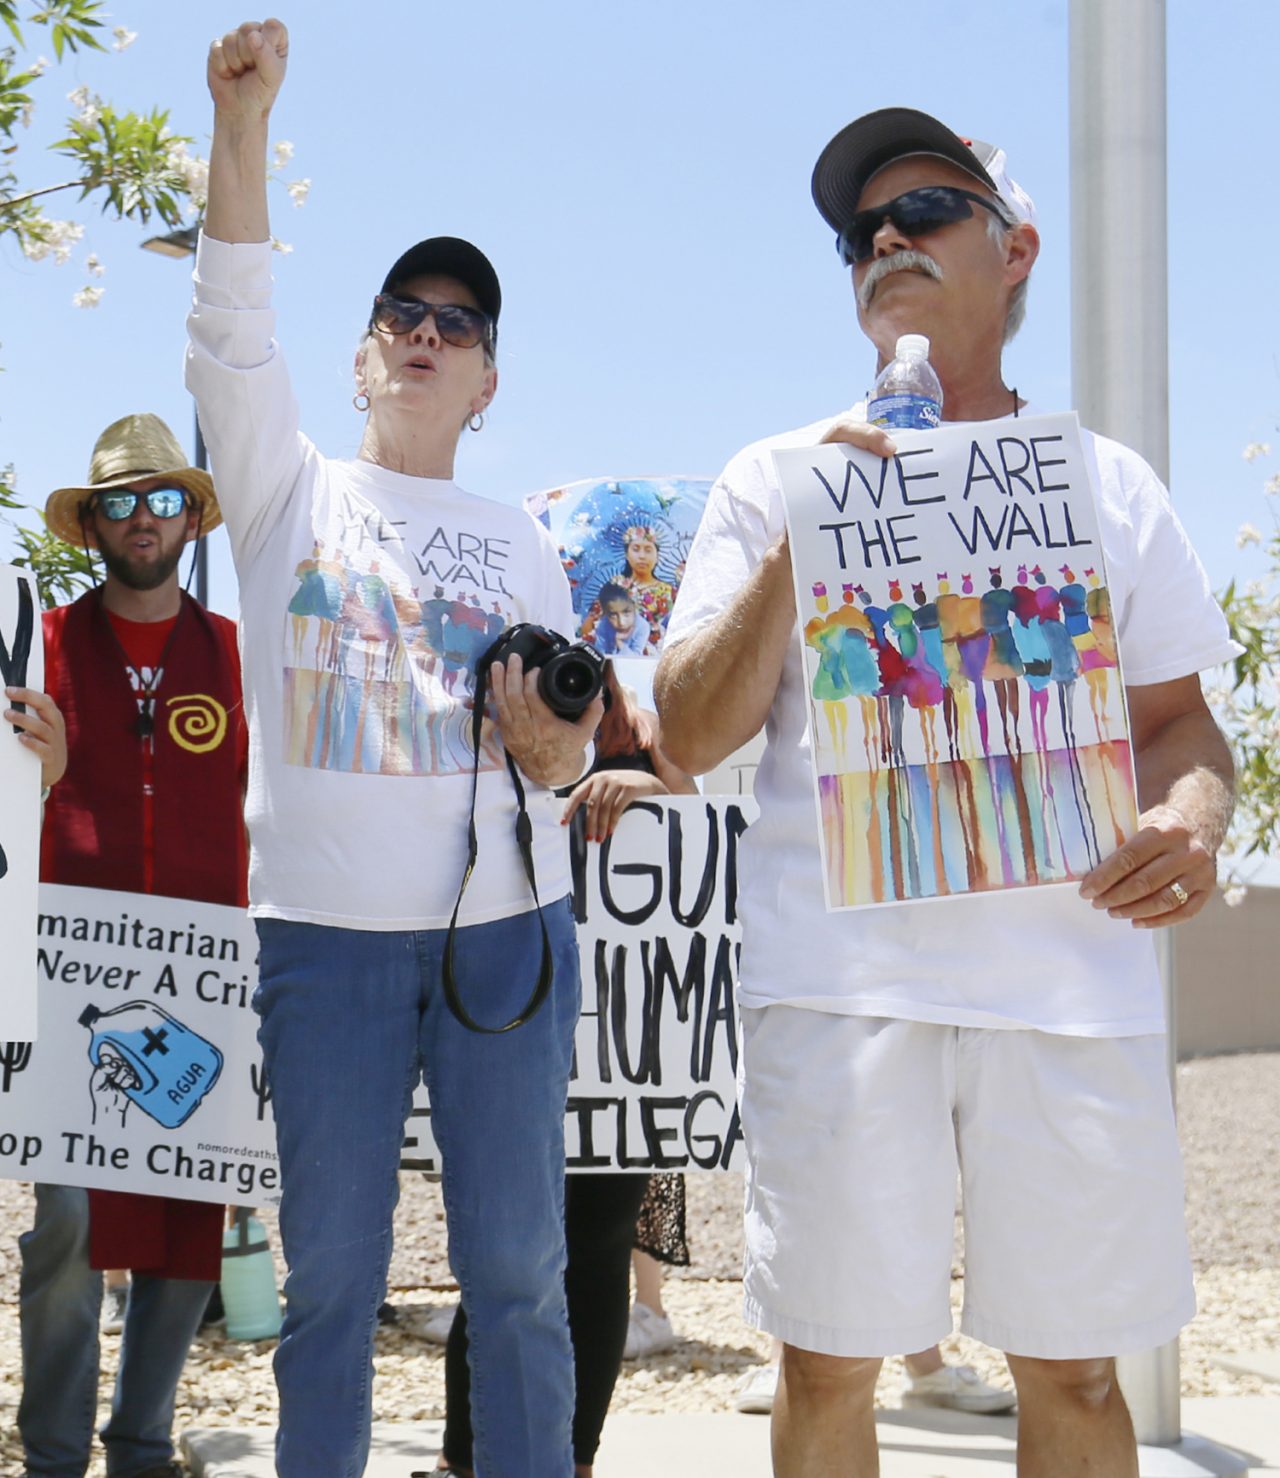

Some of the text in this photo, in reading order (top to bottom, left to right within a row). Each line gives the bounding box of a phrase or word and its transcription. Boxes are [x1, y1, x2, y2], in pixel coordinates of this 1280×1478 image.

[811, 435, 1070, 513] WE ARE
[421, 526, 511, 572] ARE
[819, 501, 1092, 569] THE WALL
[412, 551, 514, 600] WALL
[37, 913, 239, 962] manitarian
[37, 947, 248, 1008] Never A Cri
[570, 931, 741, 1087] HUMA
[167, 1063, 206, 1105] AGUA
[61, 1132, 130, 1170] The
[146, 1144, 284, 1194] Charge
